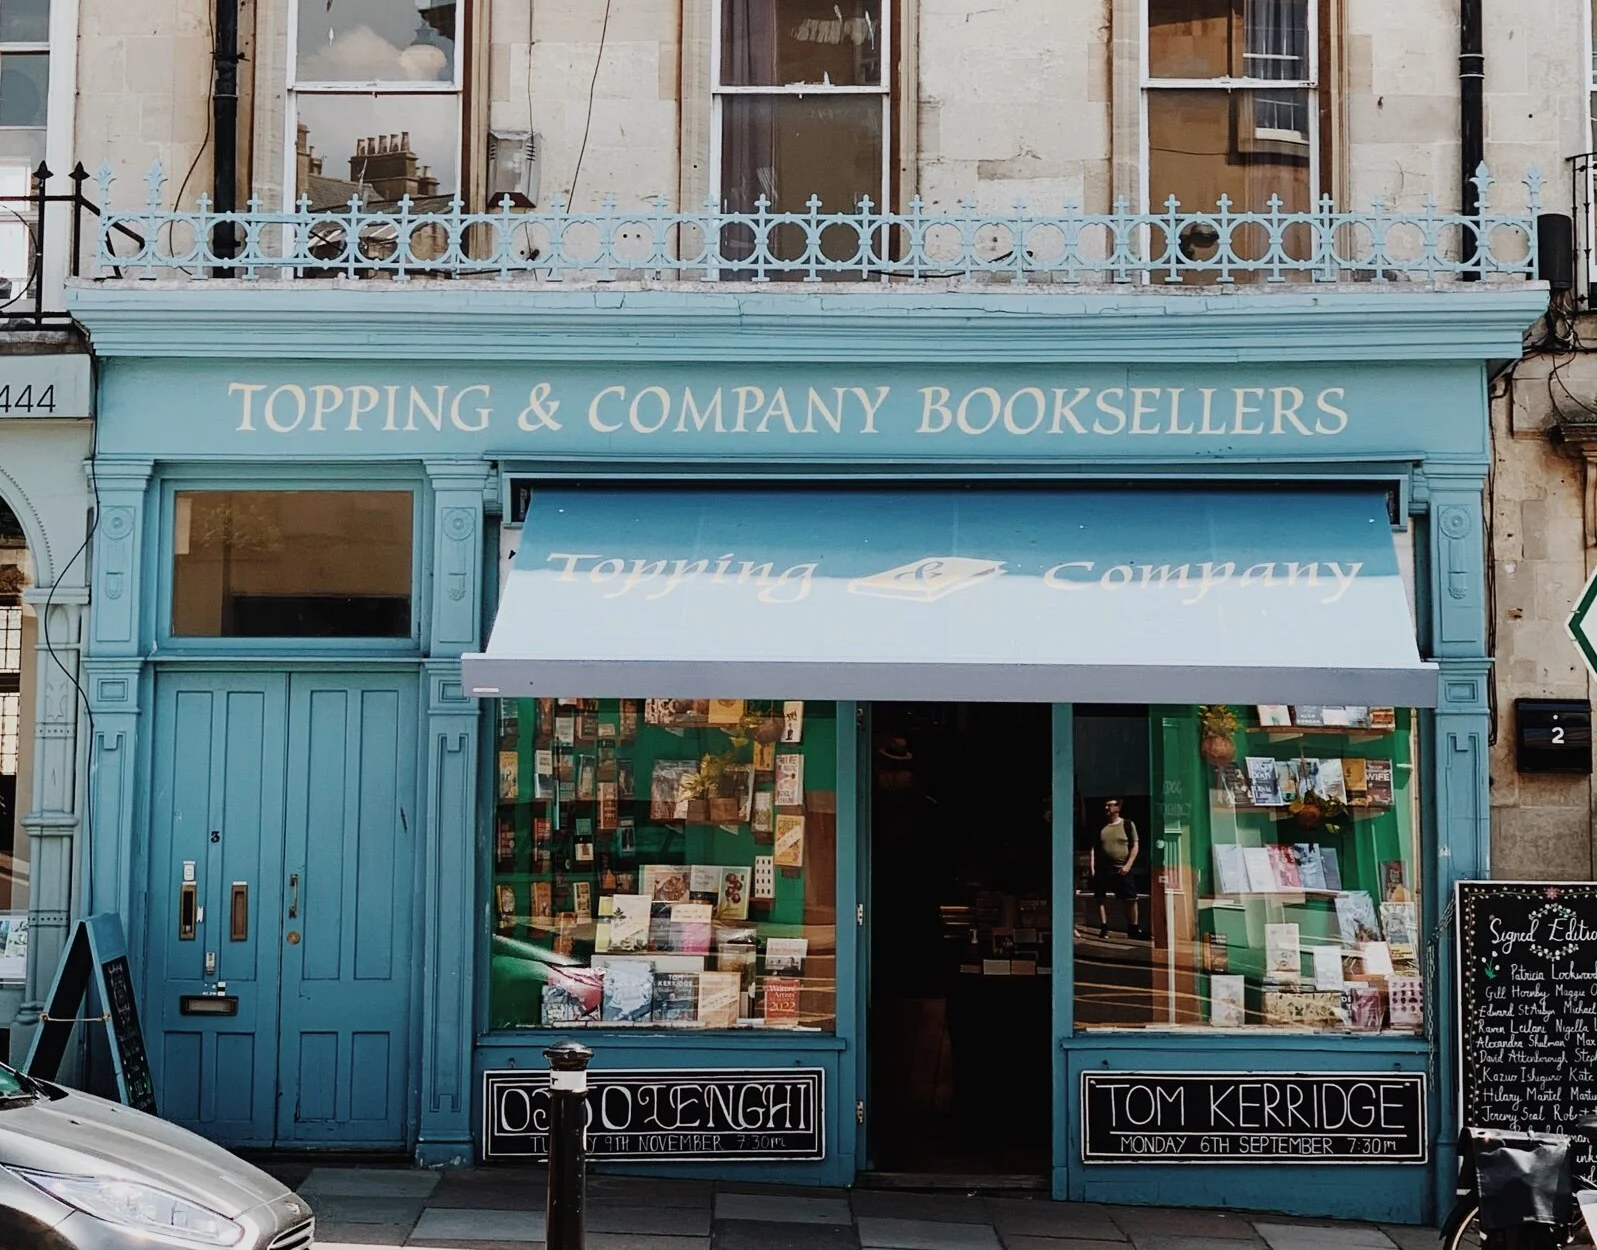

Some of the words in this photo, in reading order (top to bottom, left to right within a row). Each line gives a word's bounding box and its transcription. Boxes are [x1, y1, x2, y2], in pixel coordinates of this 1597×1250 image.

[228, 382, 494, 433] TOPPING
[517, 382, 563, 432] &
[588, 385, 891, 434] COMPANY
[915, 386, 1349, 436] BOOKSELLERS
[546, 553, 819, 603] Topping
[1043, 561, 1364, 605] Company
[1551, 726, 1565, 744] 2
[1489, 917, 1540, 955] Signed
[1511, 963, 1545, 981] Patricia
[1485, 985, 1507, 1002] Gill
[1511, 982, 1550, 1006] Hornby
[1555, 983, 1586, 1002] Maggie
[769, 1001, 796, 1012] 2022
[1479, 1003, 1515, 1018] Edward
[1563, 999, 1597, 1015] Michael
[1475, 1033, 1524, 1049] Alexandra
[1576, 1032, 1597, 1047] Max
[1477, 1018, 1506, 1034] Raven
[1555, 1018, 1590, 1041] Nigella
[1479, 1048, 1504, 1064] David
[1508, 1049, 1569, 1071] Attenborough
[1482, 1066, 1518, 1082] Kazuo
[1520, 1066, 1562, 1090] Ishiguro
[1568, 1066, 1594, 1082] Kate
[1095, 1082, 1185, 1128] TOM
[1209, 1082, 1405, 1129] KERRIDGE
[1482, 1085, 1523, 1112] Hilary
[1526, 1086, 1562, 1102] Mantel
[1481, 1105, 1518, 1130] Jeremy
[1521, 1105, 1545, 1121] Seal
[604, 1135, 630, 1152] 9TH
[638, 1134, 725, 1152] NOVEMBER
[1120, 1135, 1188, 1153] MONDAY
[1200, 1135, 1230, 1153] 6TH
[1239, 1135, 1334, 1155] SEPTEMBER
